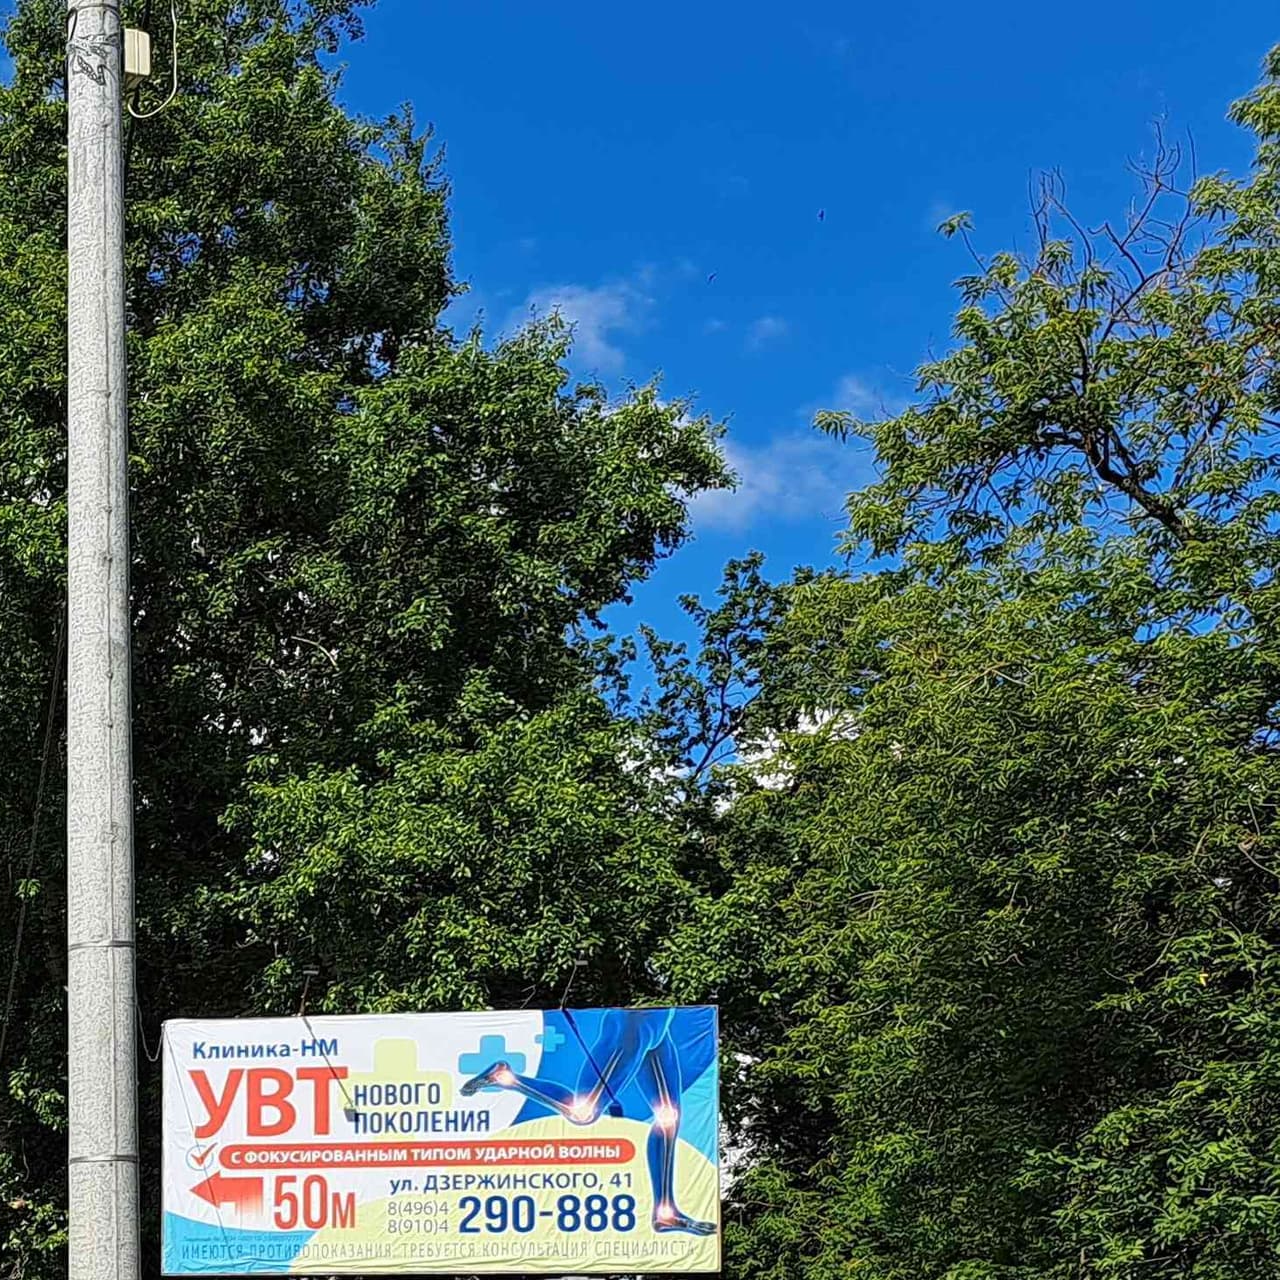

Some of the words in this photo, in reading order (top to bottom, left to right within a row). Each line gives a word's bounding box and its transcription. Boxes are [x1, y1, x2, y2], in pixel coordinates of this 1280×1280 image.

[192, 1038, 339, 1059] Клиника-НМ
[188, 1066, 349, 1139] УВТ
[354, 1083, 440, 1106] НОВОГО
[354, 1110, 490, 1134] ПОКОЛЕНИЯ
[230, 1151, 241, 1164] С
[244, 1148, 407, 1164] ФОКУСИРОВАННЫМ
[411, 1147, 471, 1162] ТИПОМ
[476, 1144, 557, 1163] УДАРНОЙ
[559, 1145, 620, 1159] ВОЛНЫ
[389, 1178, 418, 1195] ул.
[423, 1172, 604, 1193] ДЗЕРЖИНСКОГО,
[609, 1172, 633, 1188] 41
[387, 1200, 449, 1217] 8(496)4
[457, 1193, 637, 1234] 290-888
[387, 1217, 449, 1235] 8(910)4
[181, 1243, 244, 1260] ИМЕЮТСЯ
[482, 1241, 588, 1259] КОНСУЛЬТАЦИЯ
